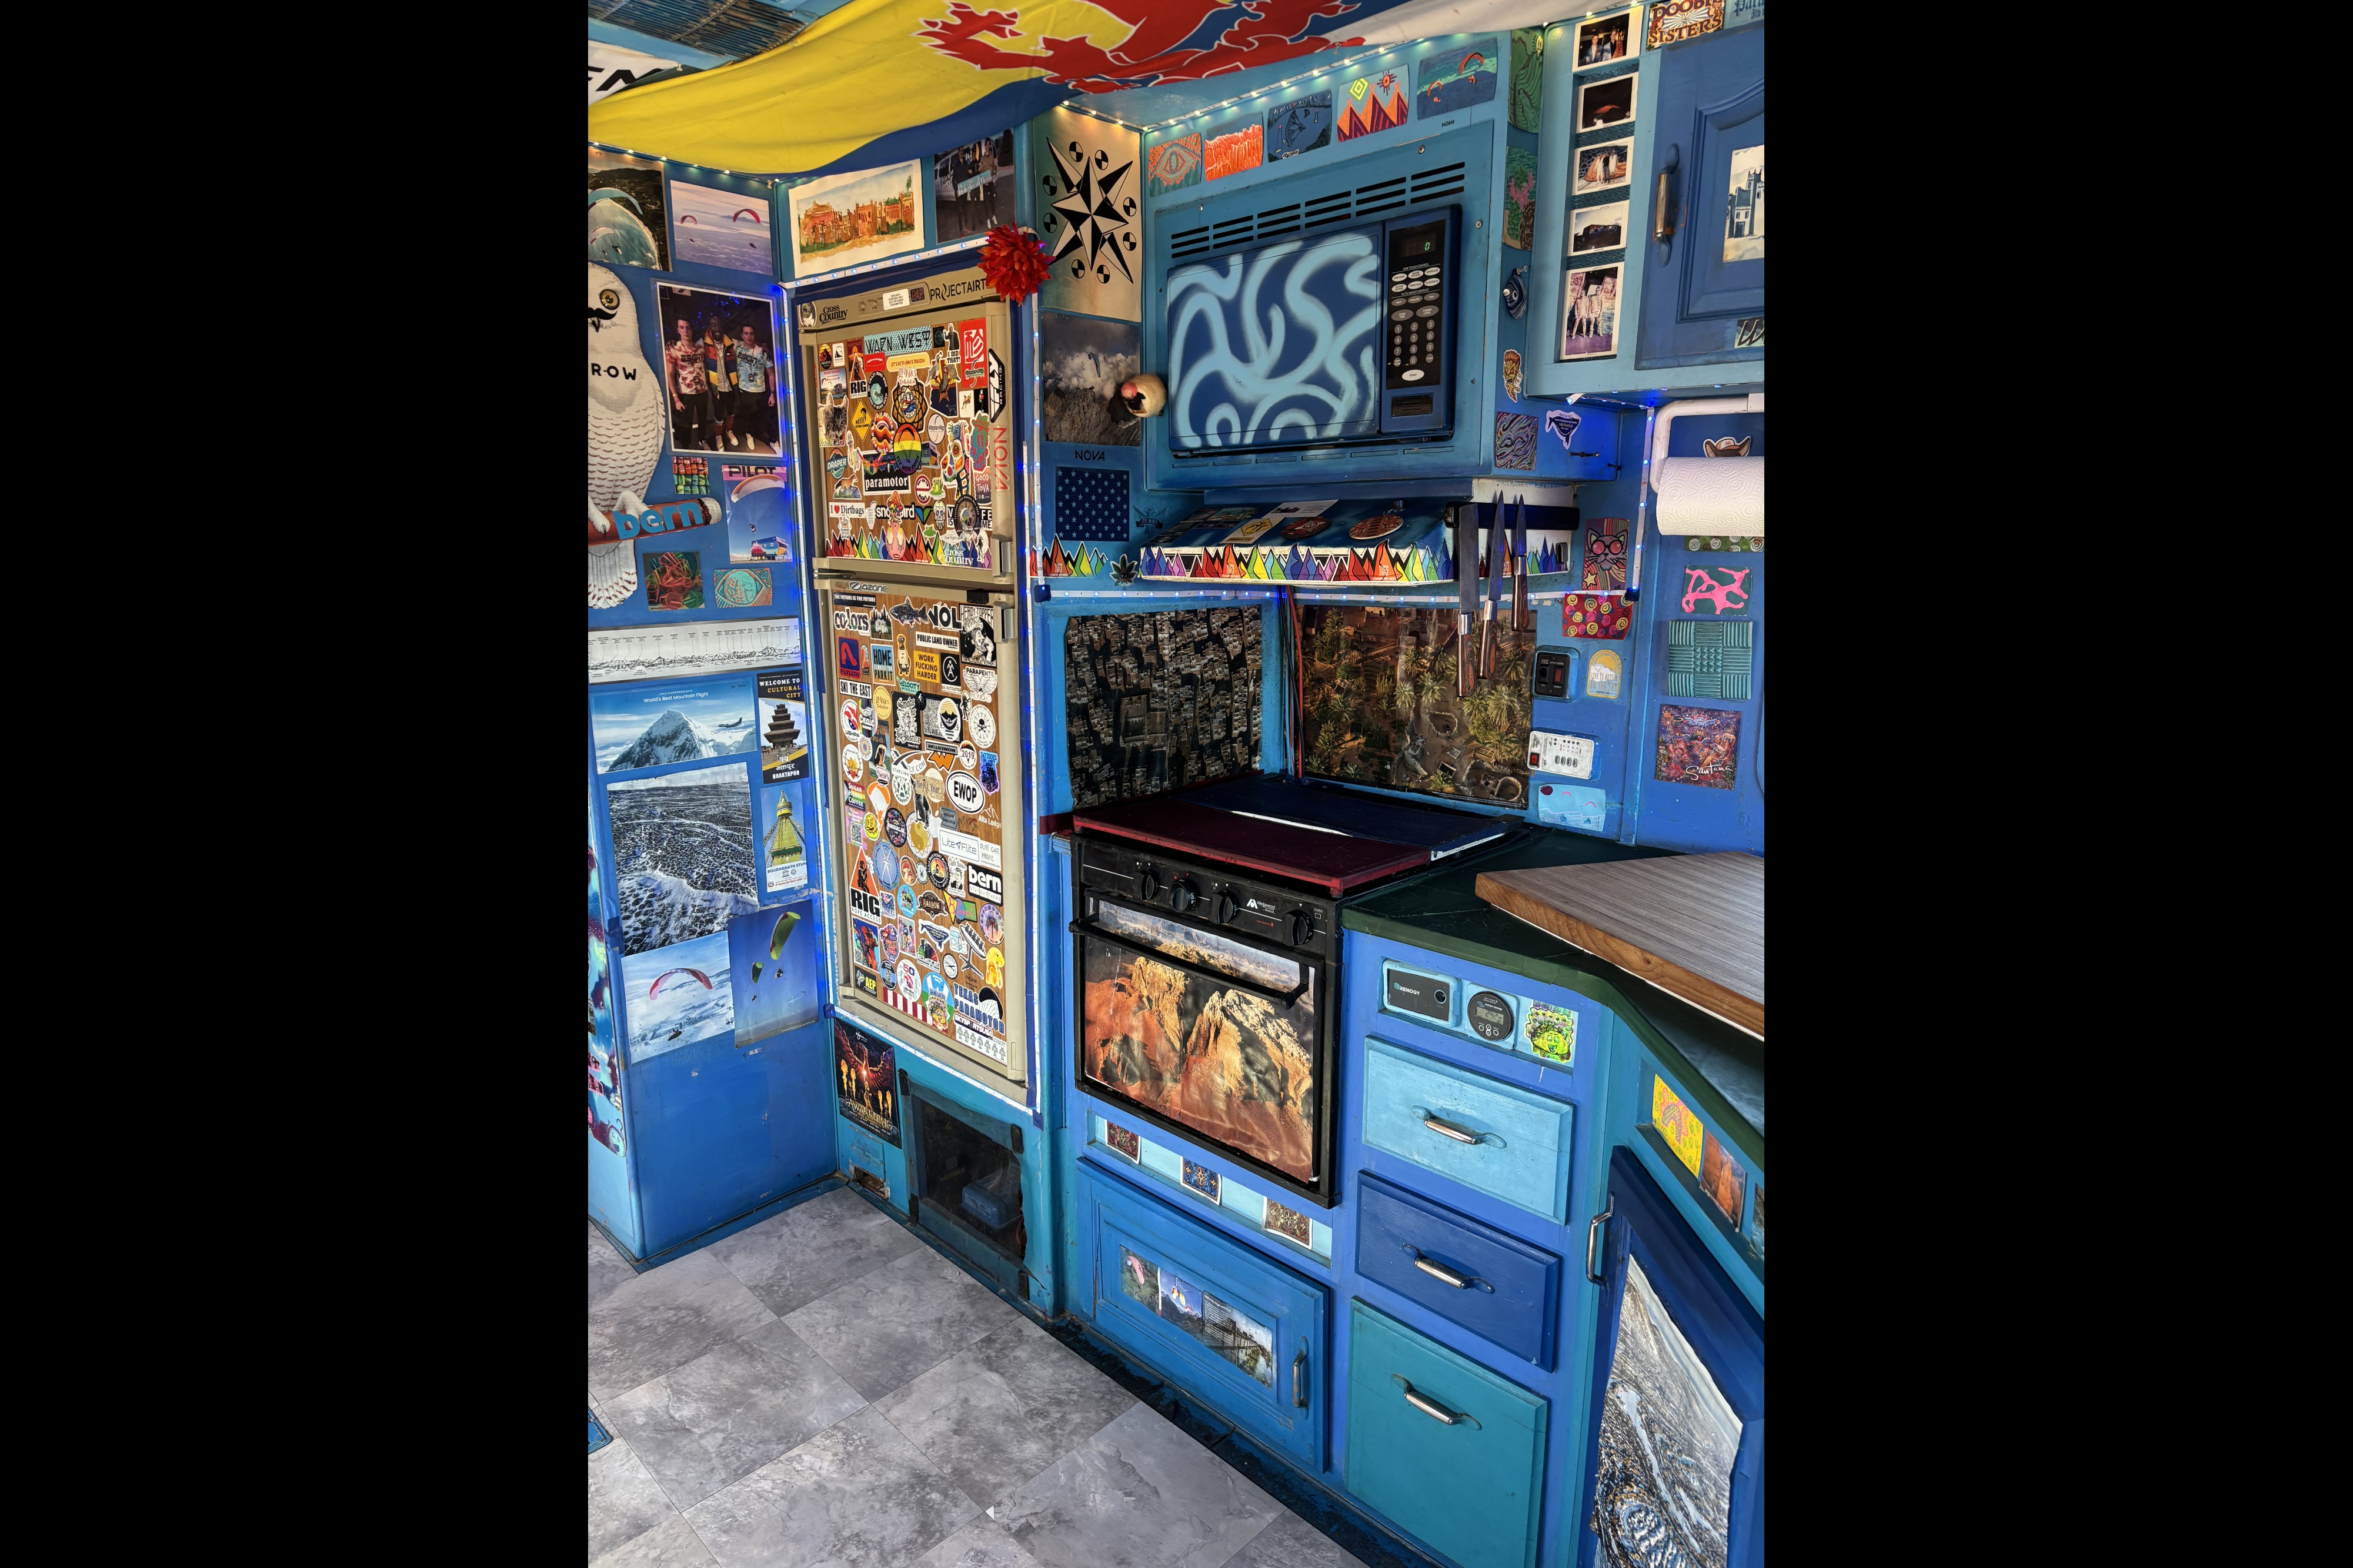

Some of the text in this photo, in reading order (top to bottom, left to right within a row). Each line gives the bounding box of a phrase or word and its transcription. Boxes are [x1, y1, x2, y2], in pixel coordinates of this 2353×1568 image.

[1648, 16, 1722, 44] SISTERS
[1441, 119, 1455, 128] NOVA
[1424, 242, 1430, 250] 0
[823, 305, 840, 313] Cross
[819, 310, 847, 323] Country
[850, 381, 867, 394] RIG
[993, 427, 1008, 490] NOVA
[1075, 450, 1106, 462] NOVA
[827, 459, 846, 469] DRAPER
[729, 466, 777, 477] PILOT
[865, 476, 908, 490] paramotor
[841, 505, 865, 517] Dirtbags
[612, 502, 704, 540] bern
[944, 548, 964, 557] Cross
[939, 554, 974, 565] Country
[835, 609, 869, 631] colors
[917, 634, 958, 647] PUBLIC LAND OWNER
[873, 649, 892, 666] HOME
[918, 654, 934, 663] WORK
[916, 661, 938, 672] FUCKING
[840, 668, 860, 677] FLYLOW
[875, 671, 893, 680] PARK IT
[917, 670, 937, 681] HARDER
[966, 668, 995, 677] PARAPENTE
[1600, 671, 1604, 680] IS
[767, 685, 801, 693] CULTURAL
[900, 678, 920, 690] VELOCITY
[1590, 680, 1617, 692] IN THE SKY
[849, 683, 858, 694] THE
[860, 684, 871, 697] EAST
[928, 744, 956, 753] MOMENTUM
[962, 750, 974, 759] 2019
[772, 770, 800, 780] BHAKTAPUR
[892, 767, 909, 777] STARLINK
[1686, 762, 1734, 781] Santana
[849, 783, 863, 793] SUGAR
[954, 781, 977, 803] EWOP
[849, 790, 863, 800] HOUSE
[848, 797, 863, 807] COFFEE
[978, 815, 1002, 828] Alta Lodge
[962, 842, 977, 854] Flite
[767, 864, 796, 873] BOUDHANATH
[969, 865, 1002, 892] bern
[989, 892, 1000, 901] THERE
[850, 888, 880, 917] RIG
[923, 899, 940, 910] SALOON
[1257, 900, 1276, 909] Wedgewood
[852, 907, 880, 923] ROPE ACCESS
[917, 954, 940, 967] ELITE
[865, 977, 876, 990] AEP
[954, 983, 979, 1005] TEXAS
[1400, 985, 1420, 996] RENOGY
[954, 999, 1004, 1034] PARAMOTOR
[846, 1098, 894, 1131] AWAKENING
